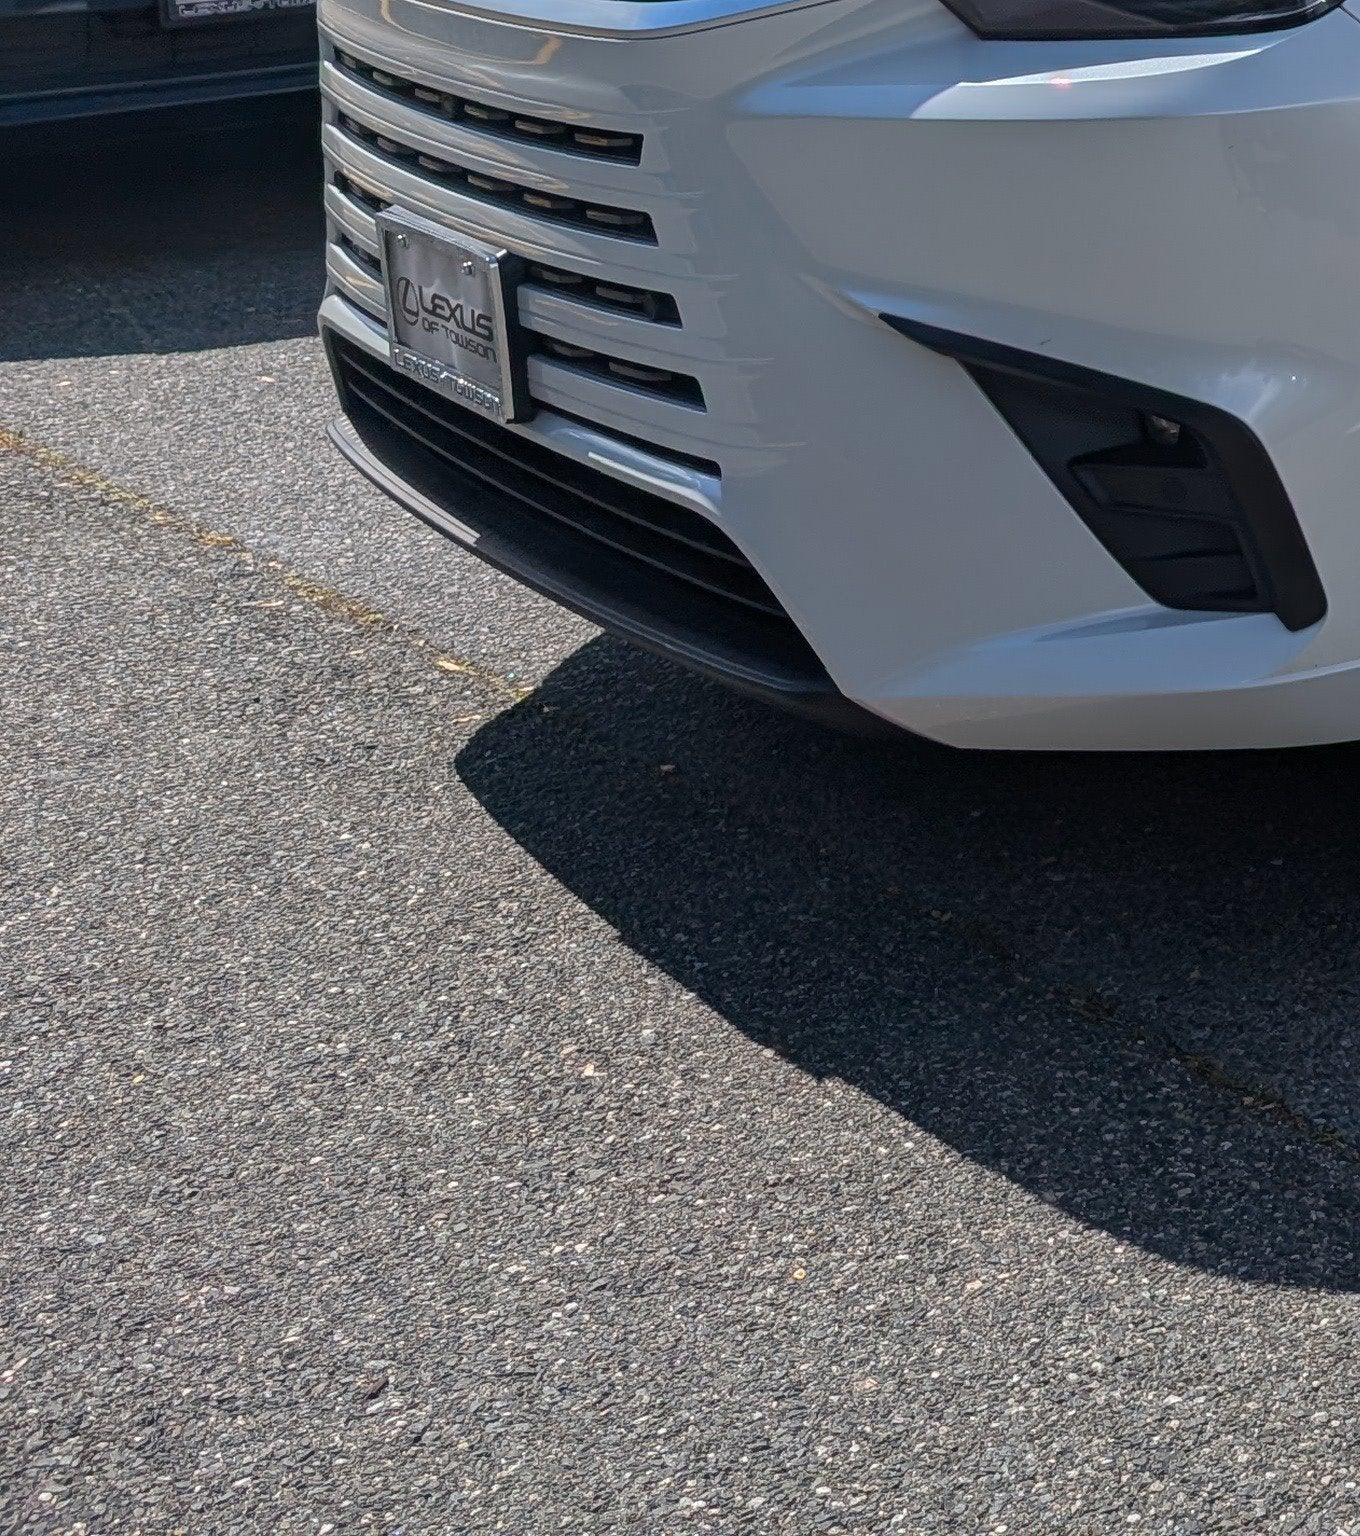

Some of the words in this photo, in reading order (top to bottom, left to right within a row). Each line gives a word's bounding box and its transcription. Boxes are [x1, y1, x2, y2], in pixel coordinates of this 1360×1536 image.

[418, 285, 494, 342] LEXUS
[422, 316, 439, 335] OF
[442, 325, 498, 363] TOWSON
